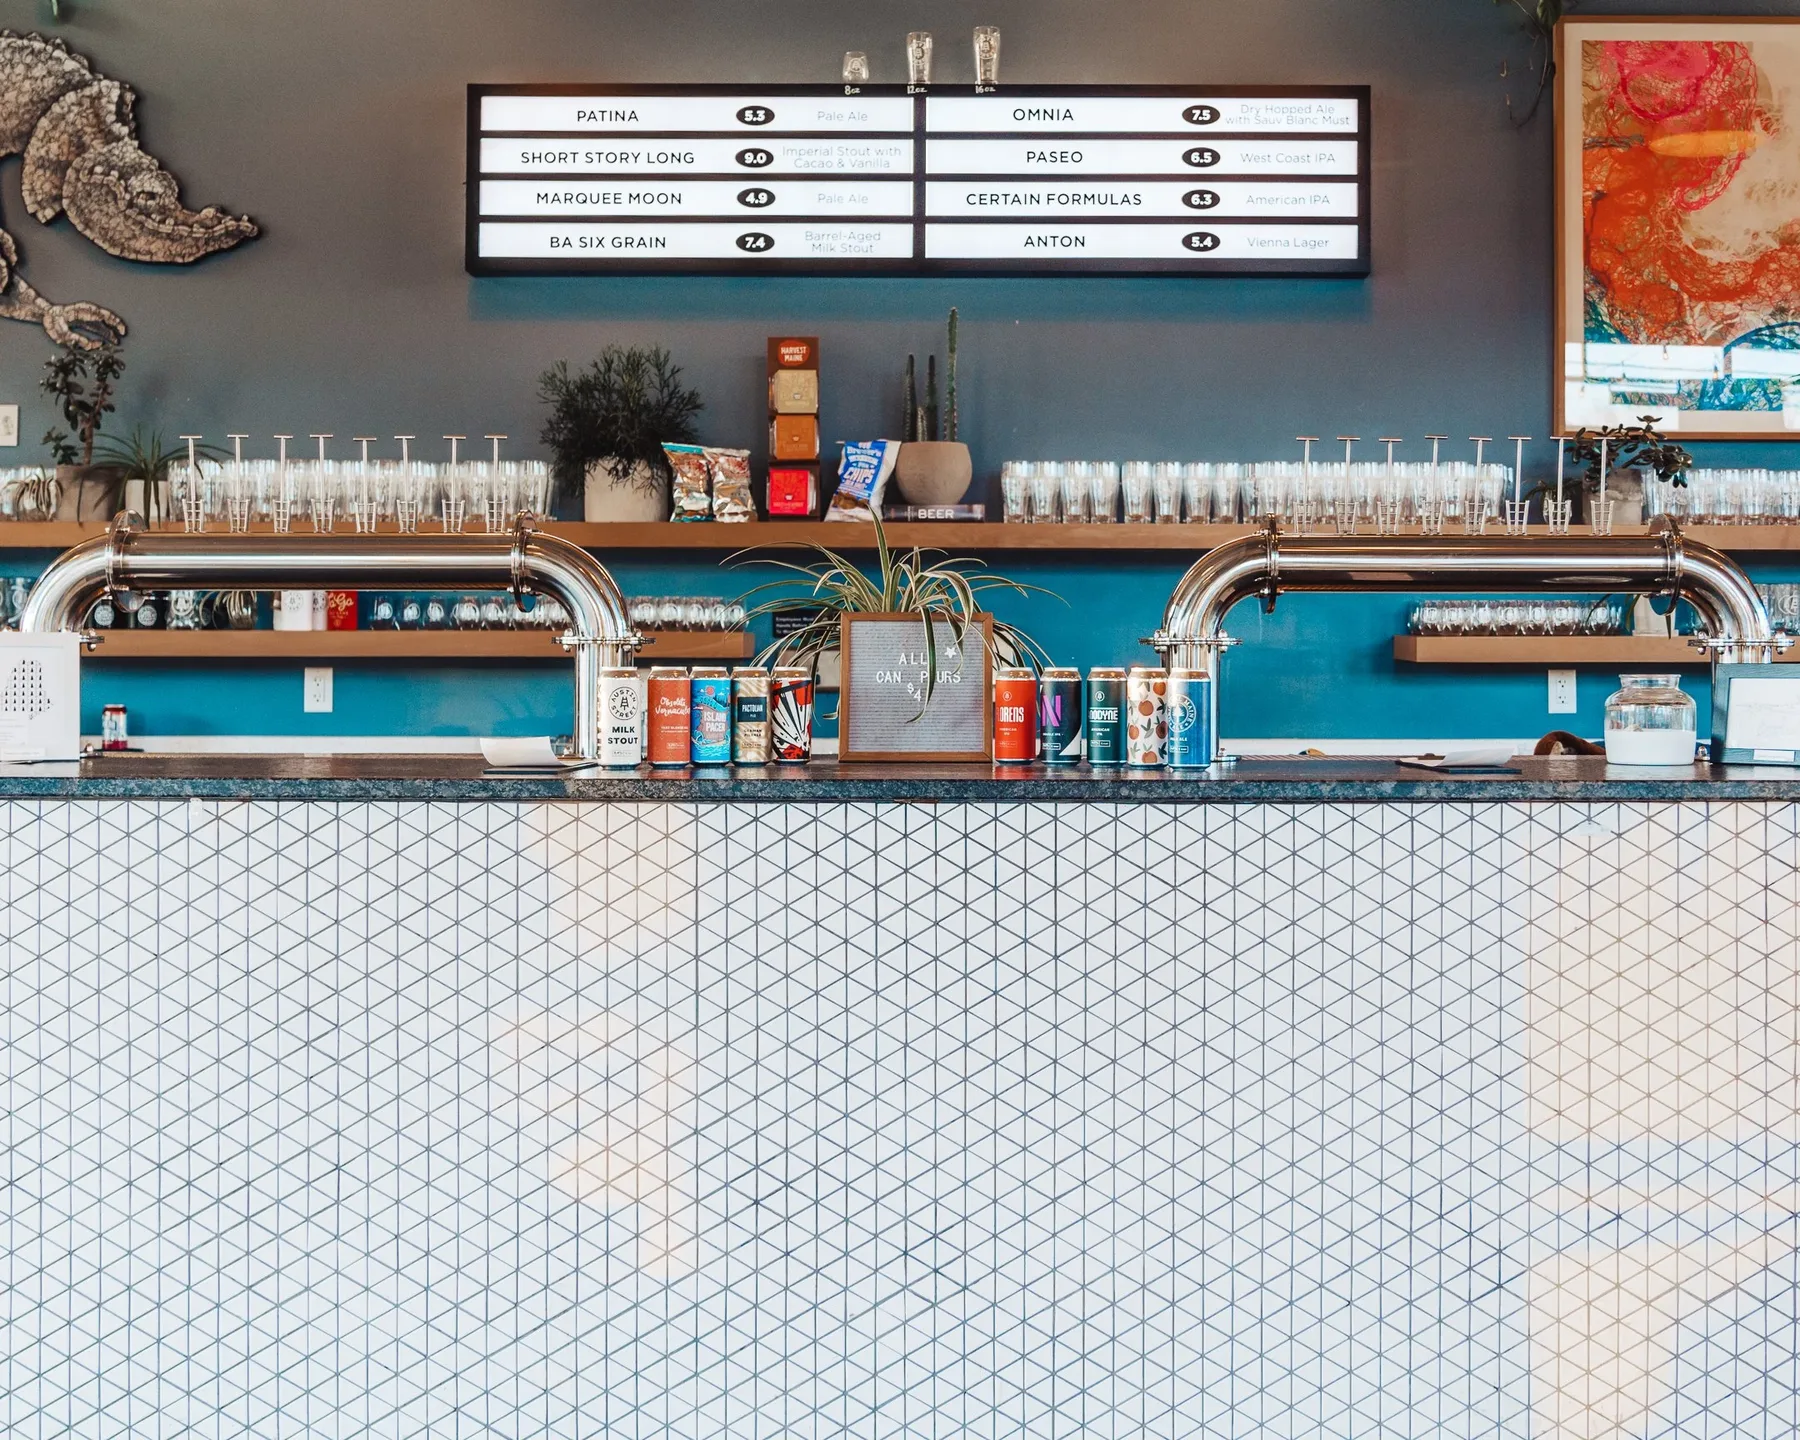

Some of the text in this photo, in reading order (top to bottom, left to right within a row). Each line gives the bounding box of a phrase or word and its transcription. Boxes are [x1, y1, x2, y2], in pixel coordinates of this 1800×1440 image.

[577, 111, 639, 121] PATINA
[744, 110, 766, 121] 5.3
[817, 111, 868, 121] Pale Ale
[1012, 109, 1074, 120] OMNIA
[1192, 109, 1211, 121] 7.5
[1240, 105, 1335, 116] Dry Hopped Ale
[1225, 115, 1350, 125] with Sauv Blanc Must
[521, 152, 695, 163] SHORT STORY LONG
[781, 147, 901, 157] Imperial Stout with
[1026, 151, 1083, 163] PASEO
[1191, 152, 1212, 163] 6.5
[744, 152, 767, 164] 9.0
[793, 158, 891, 168] Cacao & Vanilla
[1239, 153, 1271, 162] West
[1275, 153, 1311, 163] Coast
[536, 193, 682, 204] MARQUEE MOON
[745, 192, 768, 204] 4.9
[817, 194, 869, 203] Pale Ale
[966, 194, 1142, 205] CERTAIN FORMULAS
[1191, 194, 1212, 205] 6.3
[1246, 195, 1331, 204] American IPA
[550, 237, 666, 248] BA SIX GRAIN
[745, 237, 766, 248] 7.4
[805, 231, 881, 243] Barrel-Aged
[1023, 236, 1085, 247] ANTON
[1191, 236, 1213, 248] 5.4
[841, 244, 874, 253] Stout
[1247, 238, 1329, 249] Vienna Lager
[918, 509, 954, 519] BEER
[899, 653, 928, 665] ALL
[876, 671, 961, 683] CAN PURS
[611, 690, 637, 702] AUSTIN
[907, 682, 922, 702] $4
[611, 705, 637, 717] STREET
